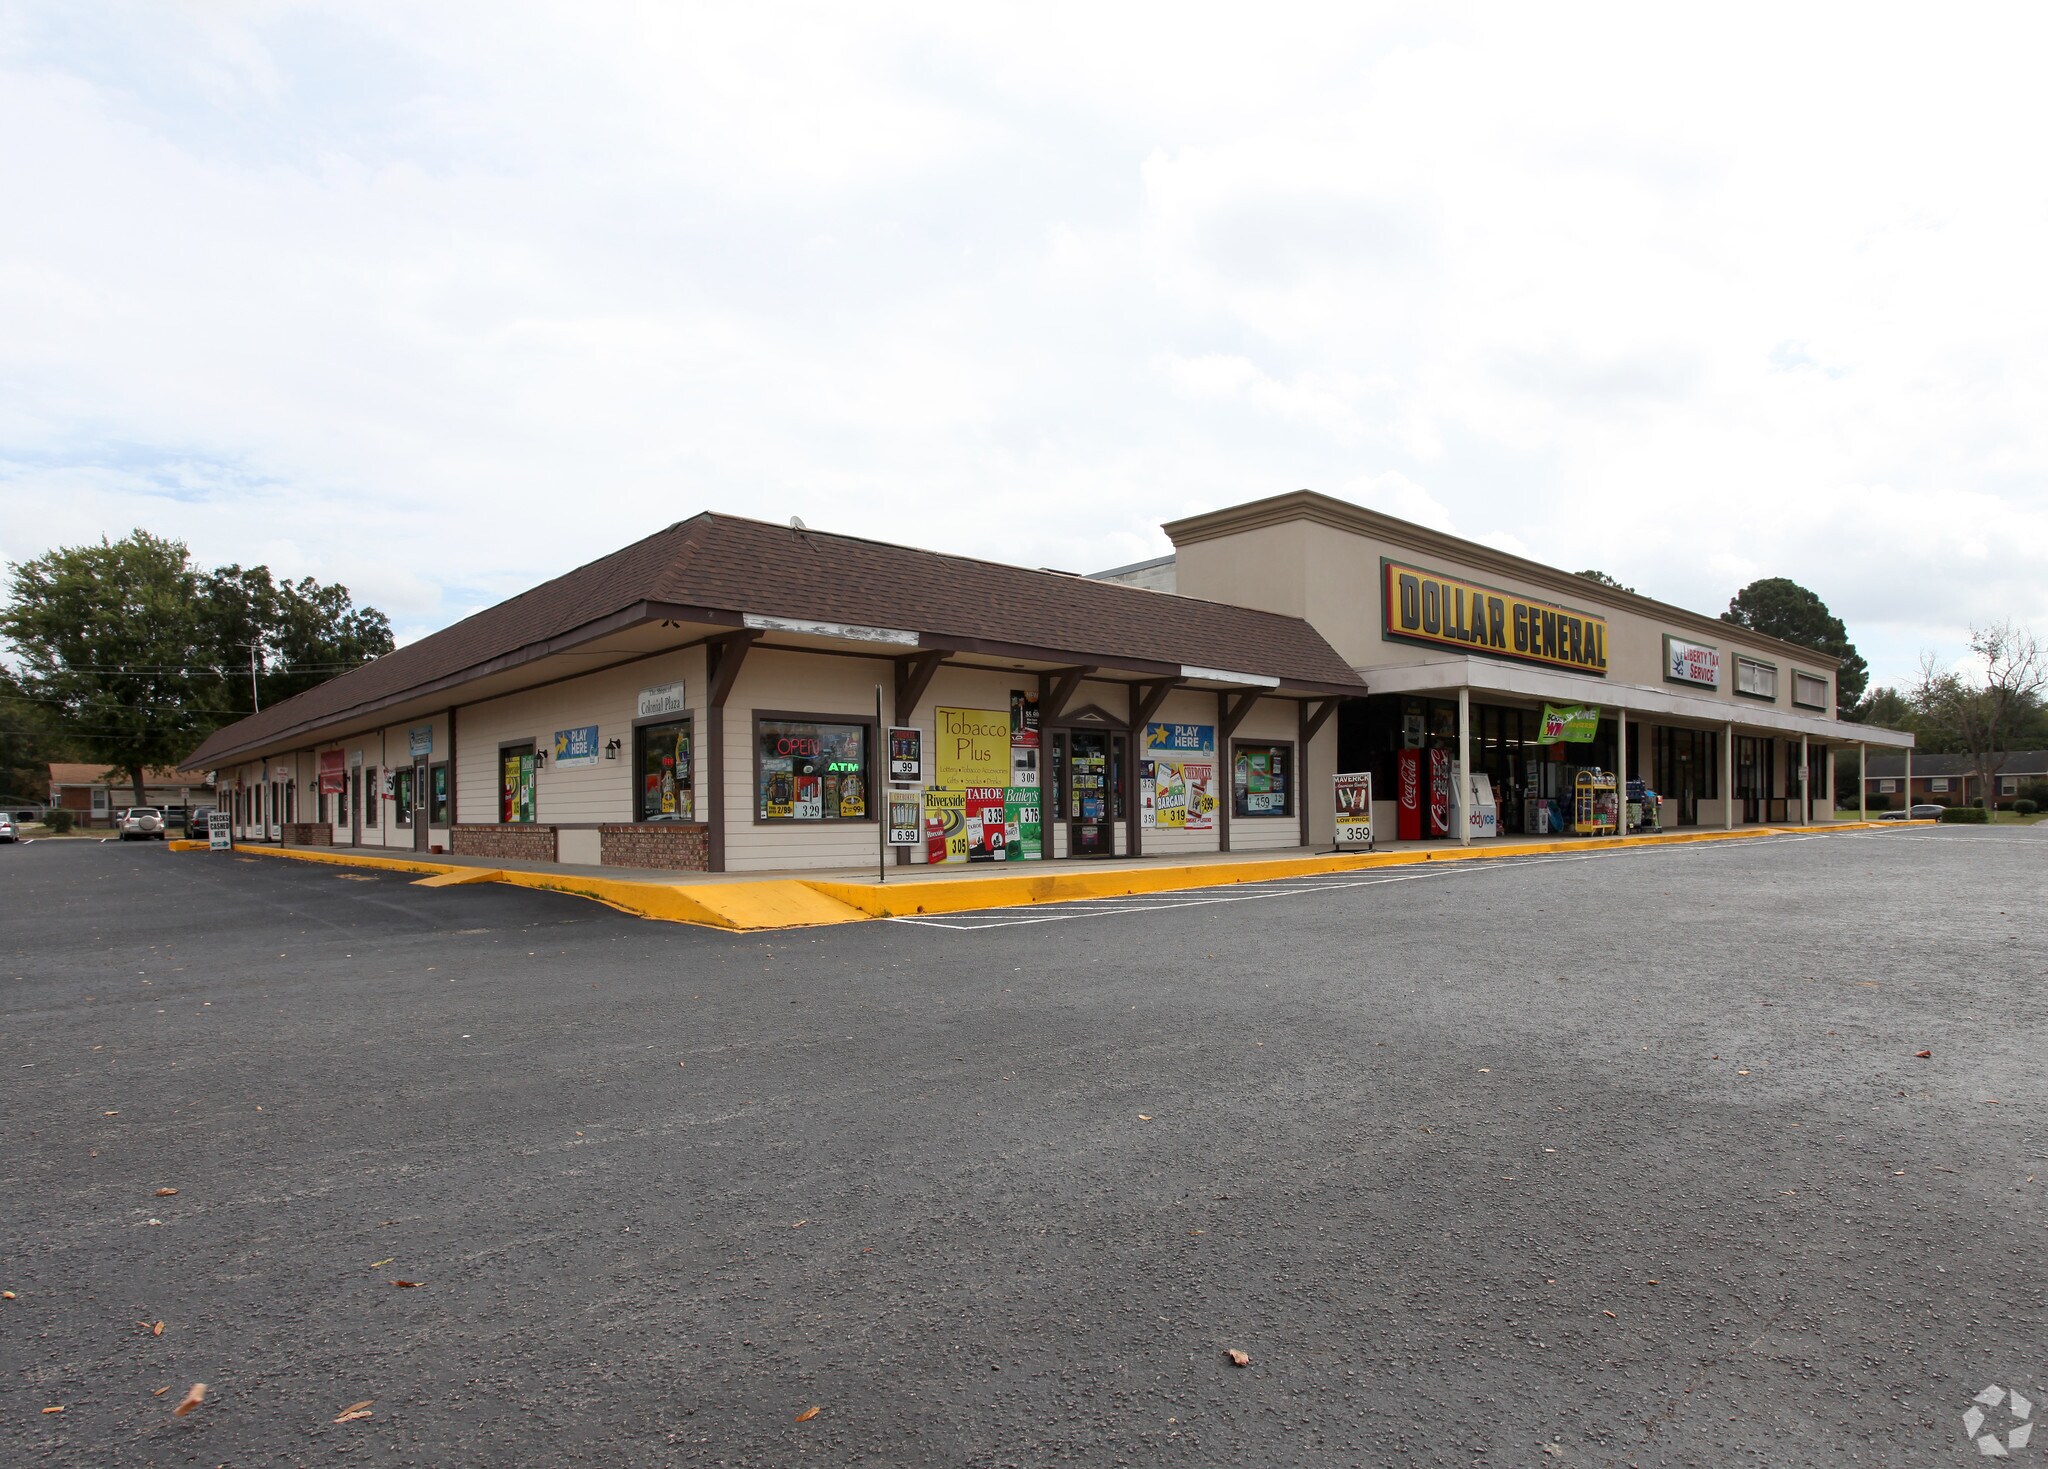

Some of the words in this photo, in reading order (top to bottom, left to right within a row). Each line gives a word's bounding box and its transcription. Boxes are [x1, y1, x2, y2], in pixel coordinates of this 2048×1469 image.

[1399, 573, 1506, 649] DOLLAR
[1513, 602, 1607, 668] GENERAL
[1683, 645, 1708, 665] LIBERTY
[1708, 651, 1720, 668] TAX
[1690, 663, 1714, 682] SERVICE
[641, 697, 664, 715] Colonial
[664, 696, 681, 710] Plaza
[939, 710, 1007, 738] Tobacco
[1175, 726, 1198, 736] PLAY
[571, 729, 587, 742] PLAY
[1175, 737, 1199, 747] HERE
[571, 742, 588, 755] HERE
[777, 738, 820, 755] OPEN
[957, 738, 991, 761] Plus
[828, 763, 859, 772] ATM
[940, 766, 958, 774] Lottery
[961, 765, 981, 774] Tobacco
[926, 793, 965, 807] Riverside
[966, 788, 1003, 800] TAHOE
[1006, 788, 1039, 803] Bailey's
[1157, 794, 1185, 811] BARGAIN
[209, 814, 230, 822] CHECKS
[897, 830, 915, 841] 6.99
